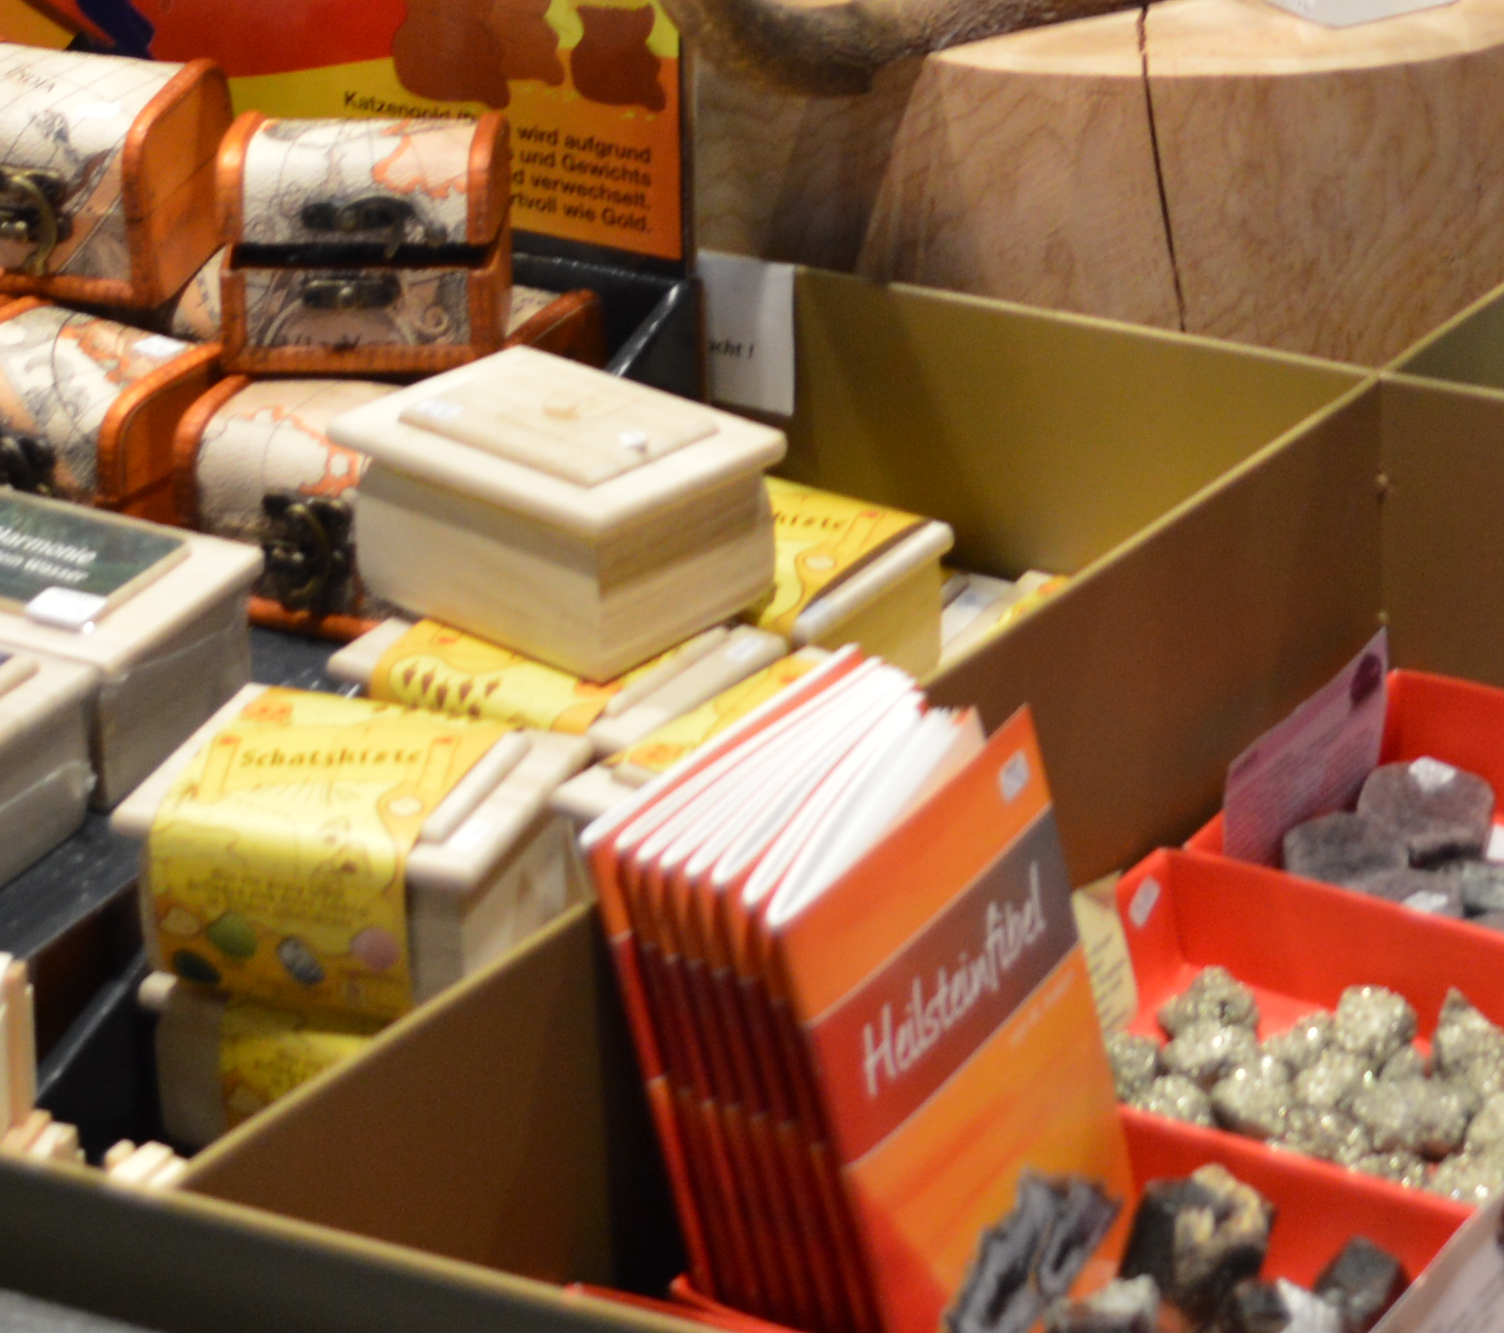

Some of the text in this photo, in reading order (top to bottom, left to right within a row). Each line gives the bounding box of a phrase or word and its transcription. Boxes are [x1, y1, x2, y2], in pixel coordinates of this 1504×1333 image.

[517, 125, 653, 165] wird aufgrund
[520, 151, 652, 188] und Gewichts
[531, 174, 652, 212] verwechselt.
[563, 201, 596, 222] wie
[601, 206, 652, 234] Gold.
[859, 861, 1047, 1098] Heilsteinfibel
